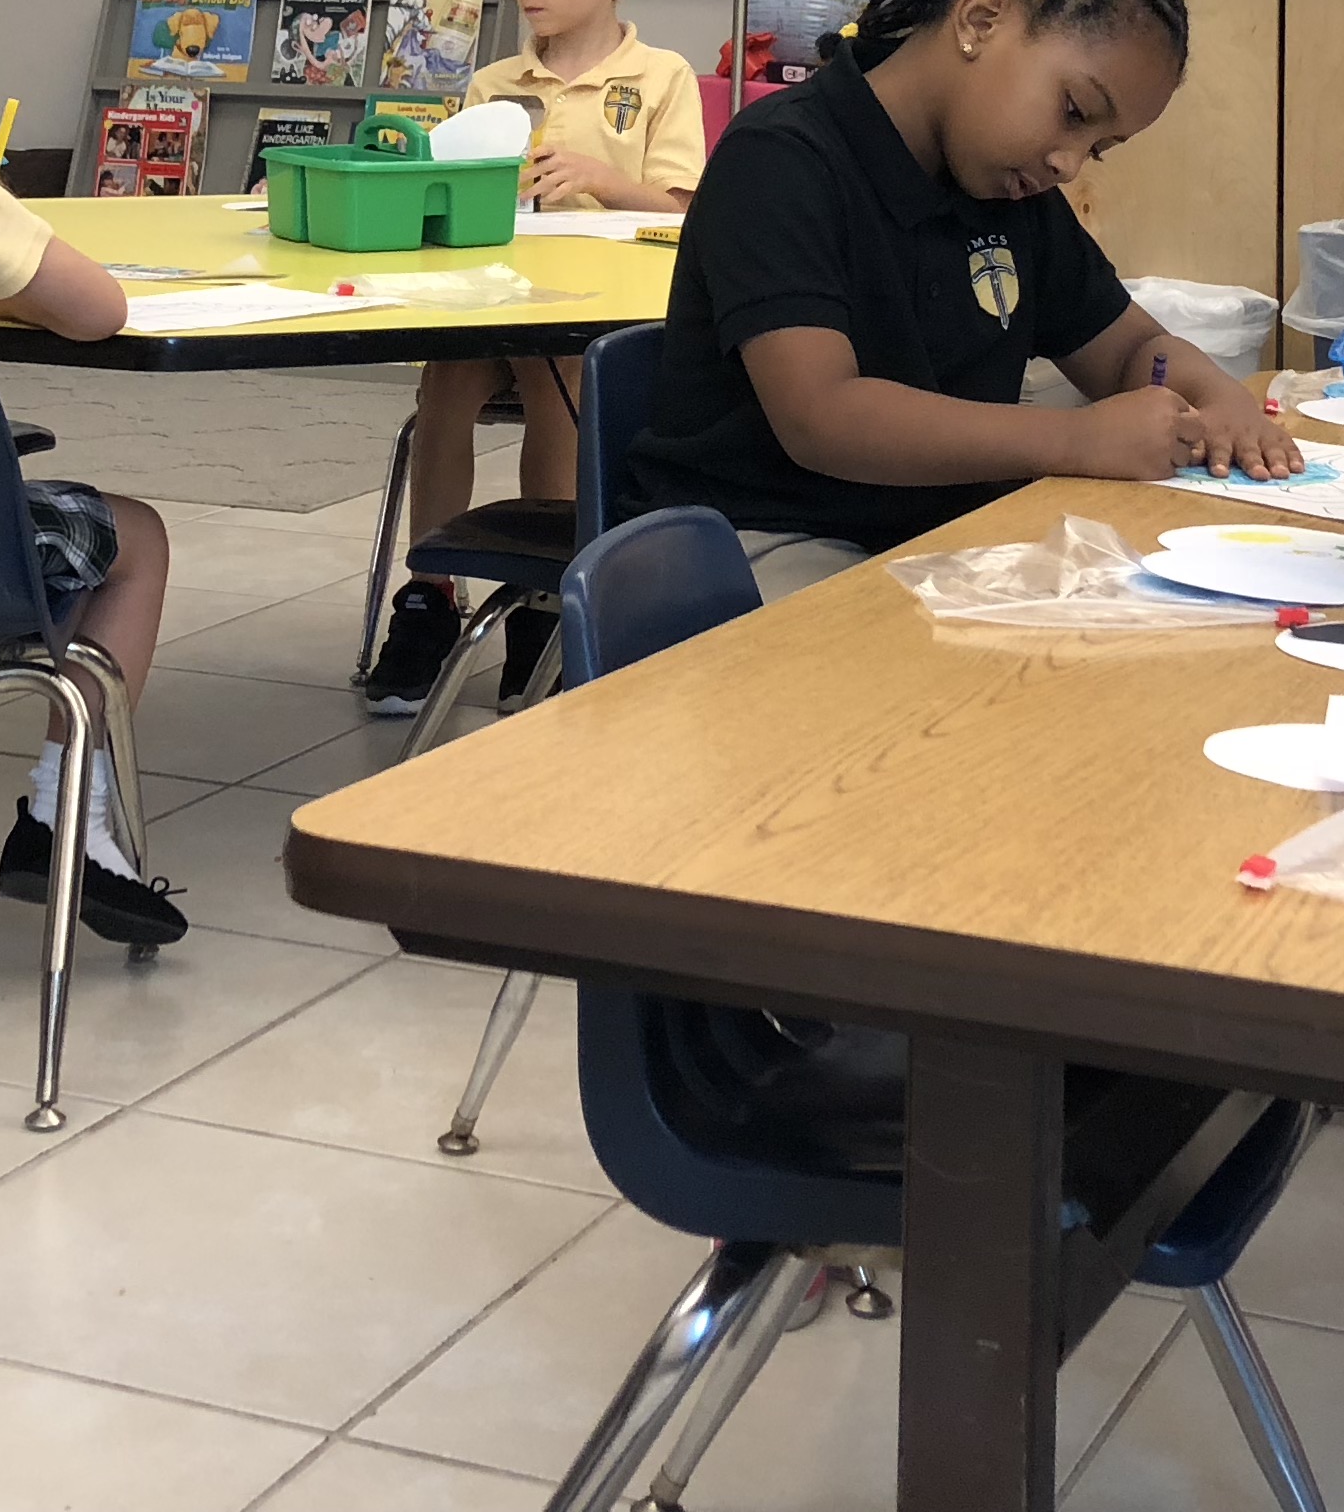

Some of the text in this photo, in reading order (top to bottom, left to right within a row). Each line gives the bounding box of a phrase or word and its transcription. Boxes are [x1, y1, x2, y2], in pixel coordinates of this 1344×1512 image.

[146, 90, 186, 105] Is Your
[107, 110, 176, 123] Kindergarten Kids
[277, 124, 315, 135] WE LIKE
